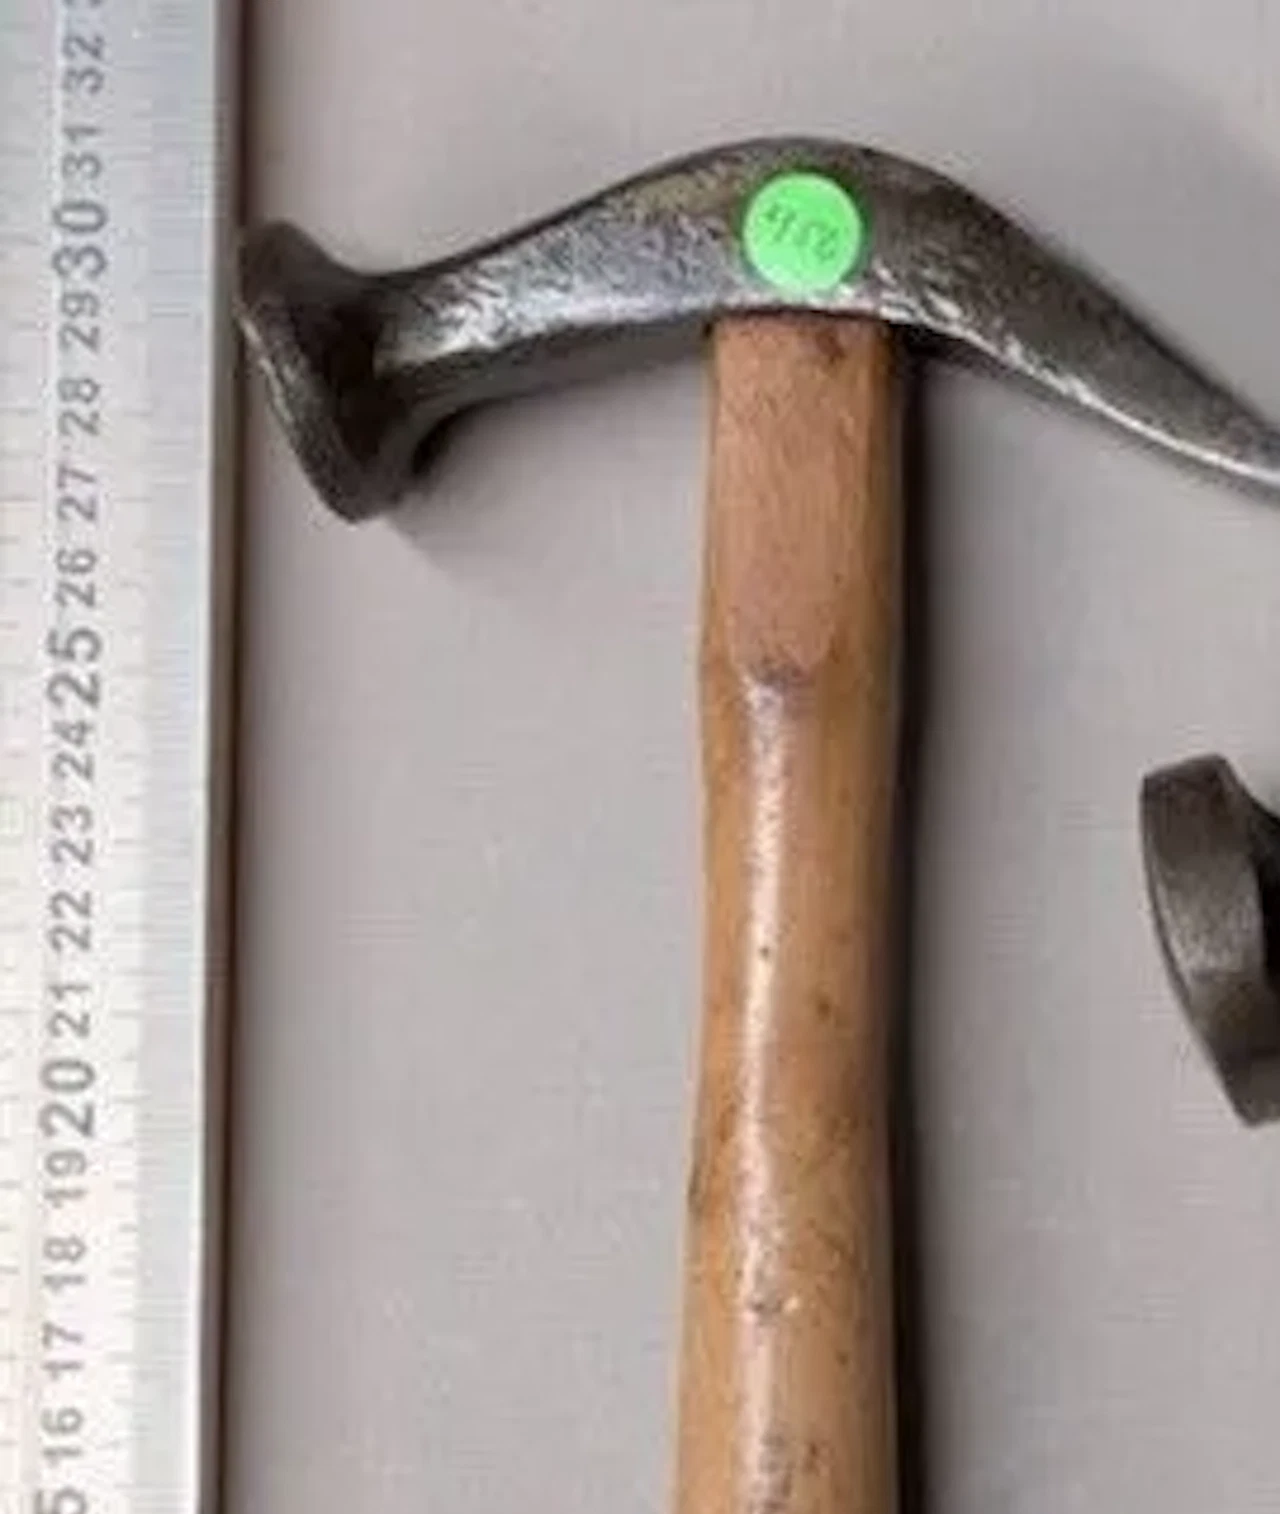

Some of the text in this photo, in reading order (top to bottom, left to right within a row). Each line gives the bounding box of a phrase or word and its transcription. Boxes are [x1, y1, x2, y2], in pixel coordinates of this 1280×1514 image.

[61, 32, 105, 95] 32
[61, 123, 104, 181] 31
[52, 200, 108, 279] 30
[58, 291, 101, 354] 29
[57, 376, 101, 437] 28
[57, 463, 99, 523] 27
[55, 548, 98, 608] 26
[46, 627, 103, 708] 25
[51, 720, 95, 782] 24
[51, 804, 95, 866] 23
[47, 889, 93, 953] 22
[47, 982, 92, 1039] 21
[40, 1058, 97, 1138] 20
[43, 1149, 88, 1208] 19
[42, 1235, 87, 1294] 18
[41, 1322, 85, 1382] 17
[41, 1405, 85, 1466] 16
